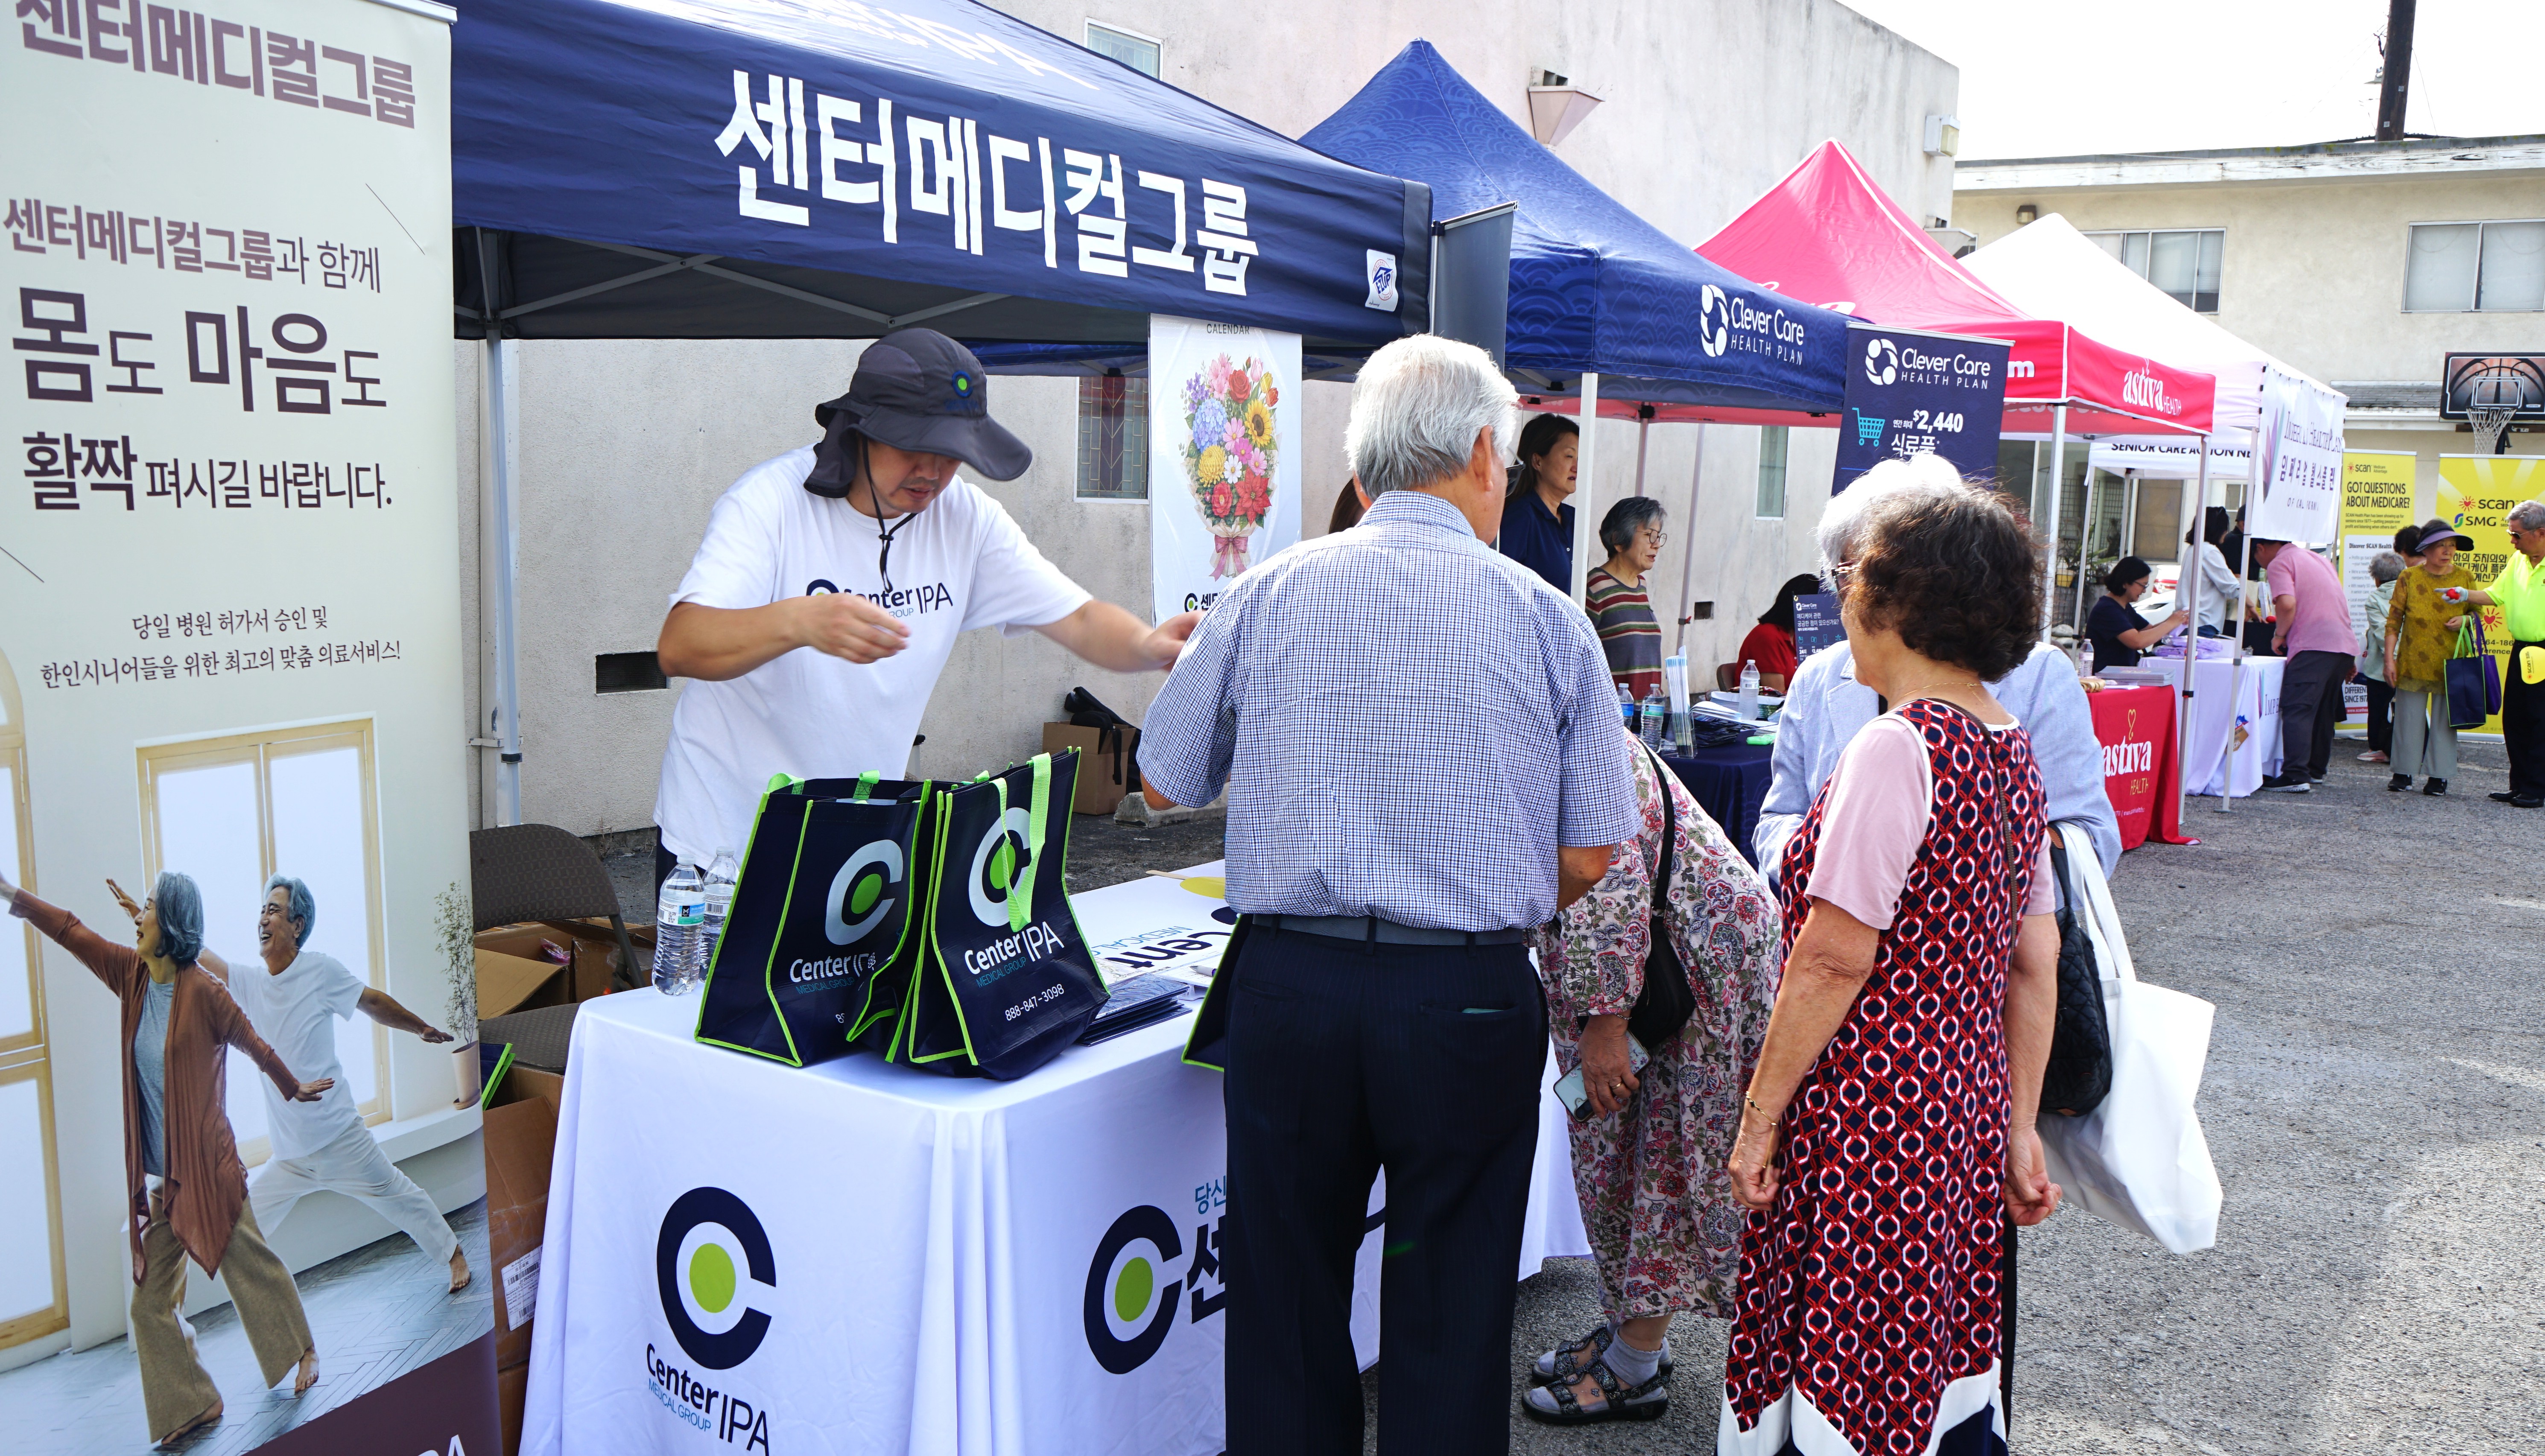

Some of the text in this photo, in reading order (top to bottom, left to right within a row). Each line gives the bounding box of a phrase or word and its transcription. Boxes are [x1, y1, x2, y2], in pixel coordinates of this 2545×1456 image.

[16, 0, 415, 129] 센터메디컬그룹
[714, 70, 1259, 295] 센터메디컬그룹
[3, 198, 380, 293] 센터메디컬그룹과 함께
[1207, 324, 1250, 334] CALENDAR
[1731, 298, 1804, 345] Clever Care
[13, 286, 387, 414] 몸도 마음도
[1731, 334, 1802, 365] HEALTH PLAN
[1902, 348, 1951, 372] Clever
[1954, 354, 1991, 376] Care
[1901, 371, 1988, 389] HEALTH PLAN
[2123, 367, 2164, 412] astiva
[2163, 395, 2181, 416] HEALTH
[1893, 409, 1963, 434] 연간 최대 $2,440
[2111, 443, 2155, 453] SENIOR
[2159, 446, 2186, 454] CARE
[22, 432, 392, 511] 활짝 펴시길 바랍니다.
[2355, 464, 2371, 473] scan
[2346, 496, 2410, 508] ABOUT MEDICARE?
[2347, 481, 2406, 494] GOT QUESTIONS
[2478, 499, 2515, 510] scan
[2465, 516, 2496, 526] SMG
[2453, 553, 2507, 563] 하의 주치의와
[844, 582, 953, 614] nter IPA
[889, 608, 914, 618] ROUP
[132, 605, 327, 640] 당일 병원 허가서 승인 및
[41, 640, 400, 689] 한인시니어들을 위한 최고의 맞춤 의료서비스!
[2265, 694, 2280, 716] IMPE
[2102, 735, 2152, 777] astiva
[2130, 778, 2149, 796] HEALTH
[964, 921, 1065, 975] Center IPA
[1104, 931, 1233, 969] Cent
[790, 955, 851, 983] Center
[976, 957, 1026, 988] MEDICAL GROUP
[796, 977, 855, 994] MEDICAL GROUP
[1005, 983, 1065, 1021] 888-847-3098
[1195, 1175, 1226, 1214] 당신
[647, 1343, 769, 1456] Center IPA
[649, 1377, 711, 1432] MEDICAL GROUP
